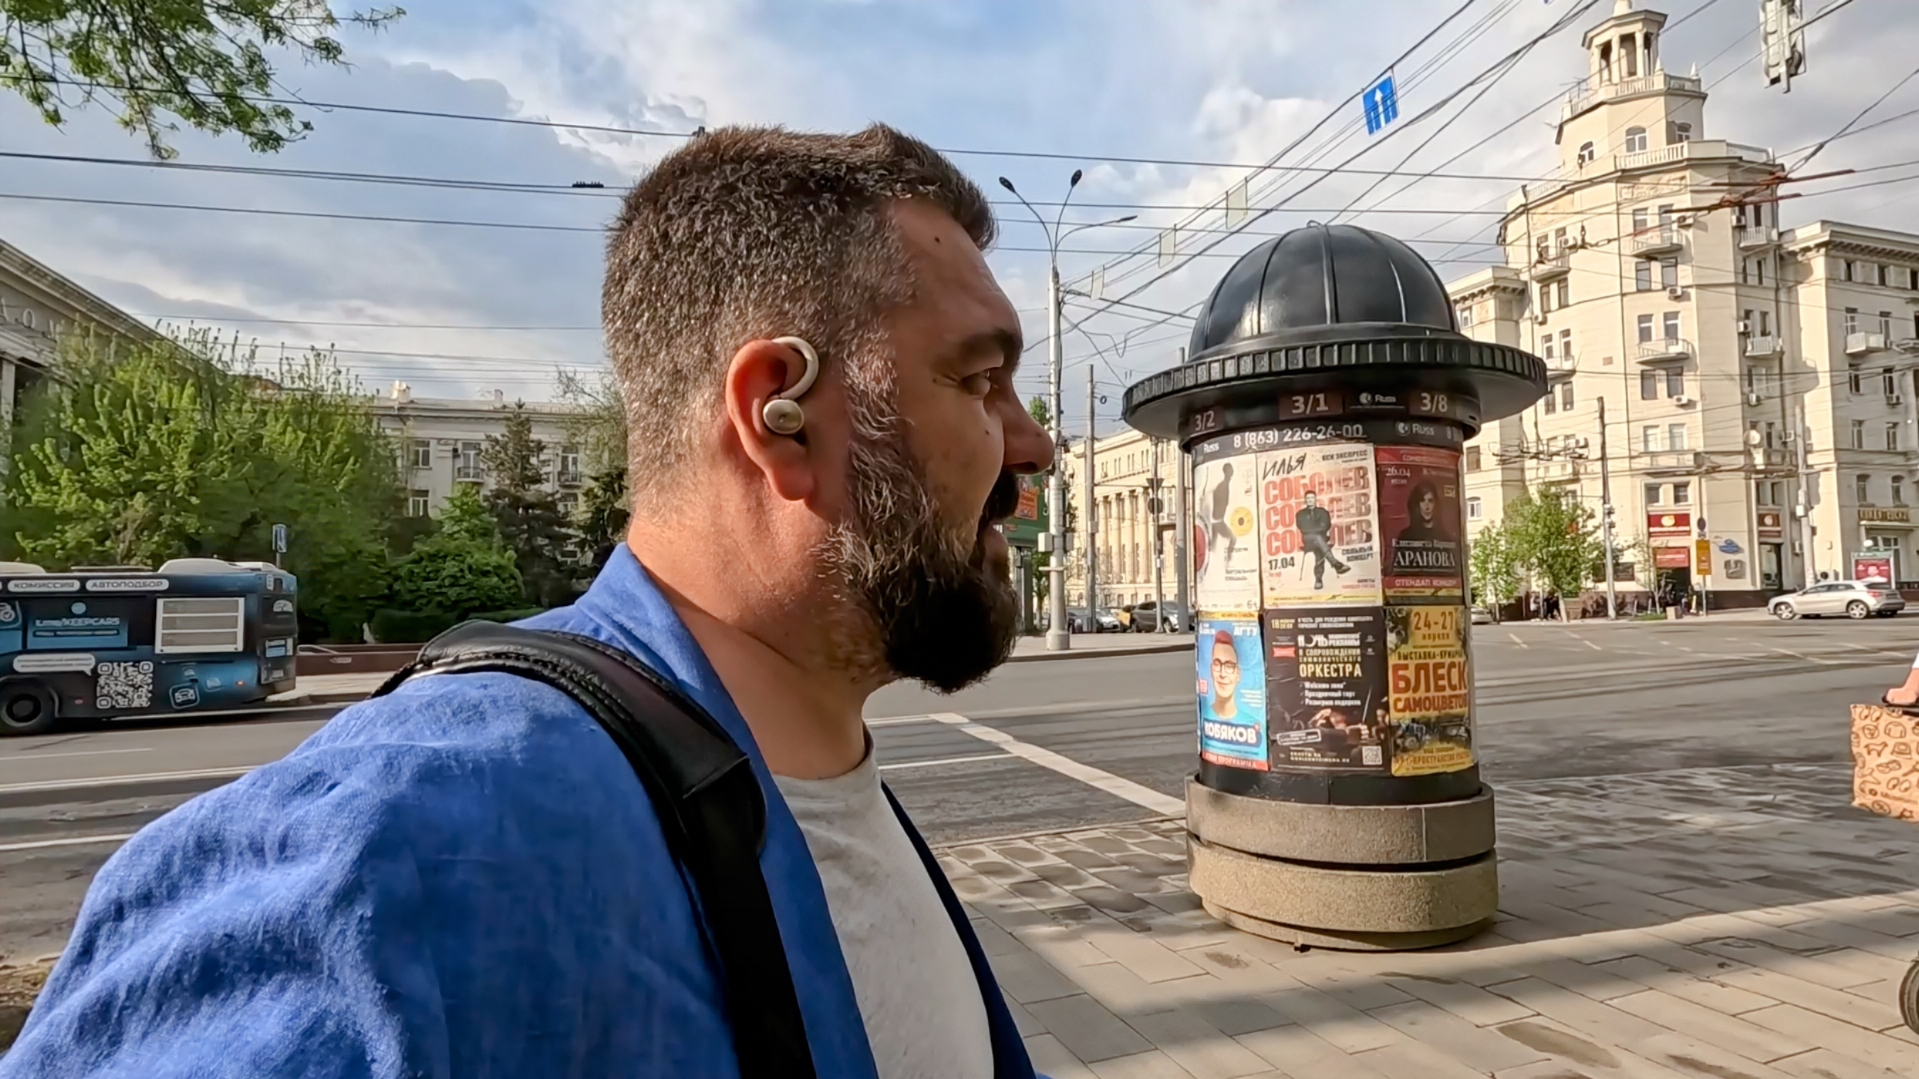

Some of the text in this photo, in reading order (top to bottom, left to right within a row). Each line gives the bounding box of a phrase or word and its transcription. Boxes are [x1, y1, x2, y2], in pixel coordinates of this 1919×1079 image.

[1292, 393, 1329, 415] 3/1
[1421, 393, 1448, 414] 3/8
[1195, 411, 1215, 431] 3/2
[1233, 434, 1242, 448] 8
[1245, 428, 1279, 447] (863)
[1283, 424, 1364, 442] 226-26-00
[1263, 453, 1307, 481] ИЛЬЯ
[1386, 466, 1411, 478] 26.04
[1268, 556, 1295, 571] 17.04
[1393, 550, 1456, 567] АРАНОВА
[91, 581, 164, 590] АВТОПОДБОР
[1299, 663, 1363, 678] ОРКЕСТРА
[1392, 661, 1468, 695] БЛЕСК
